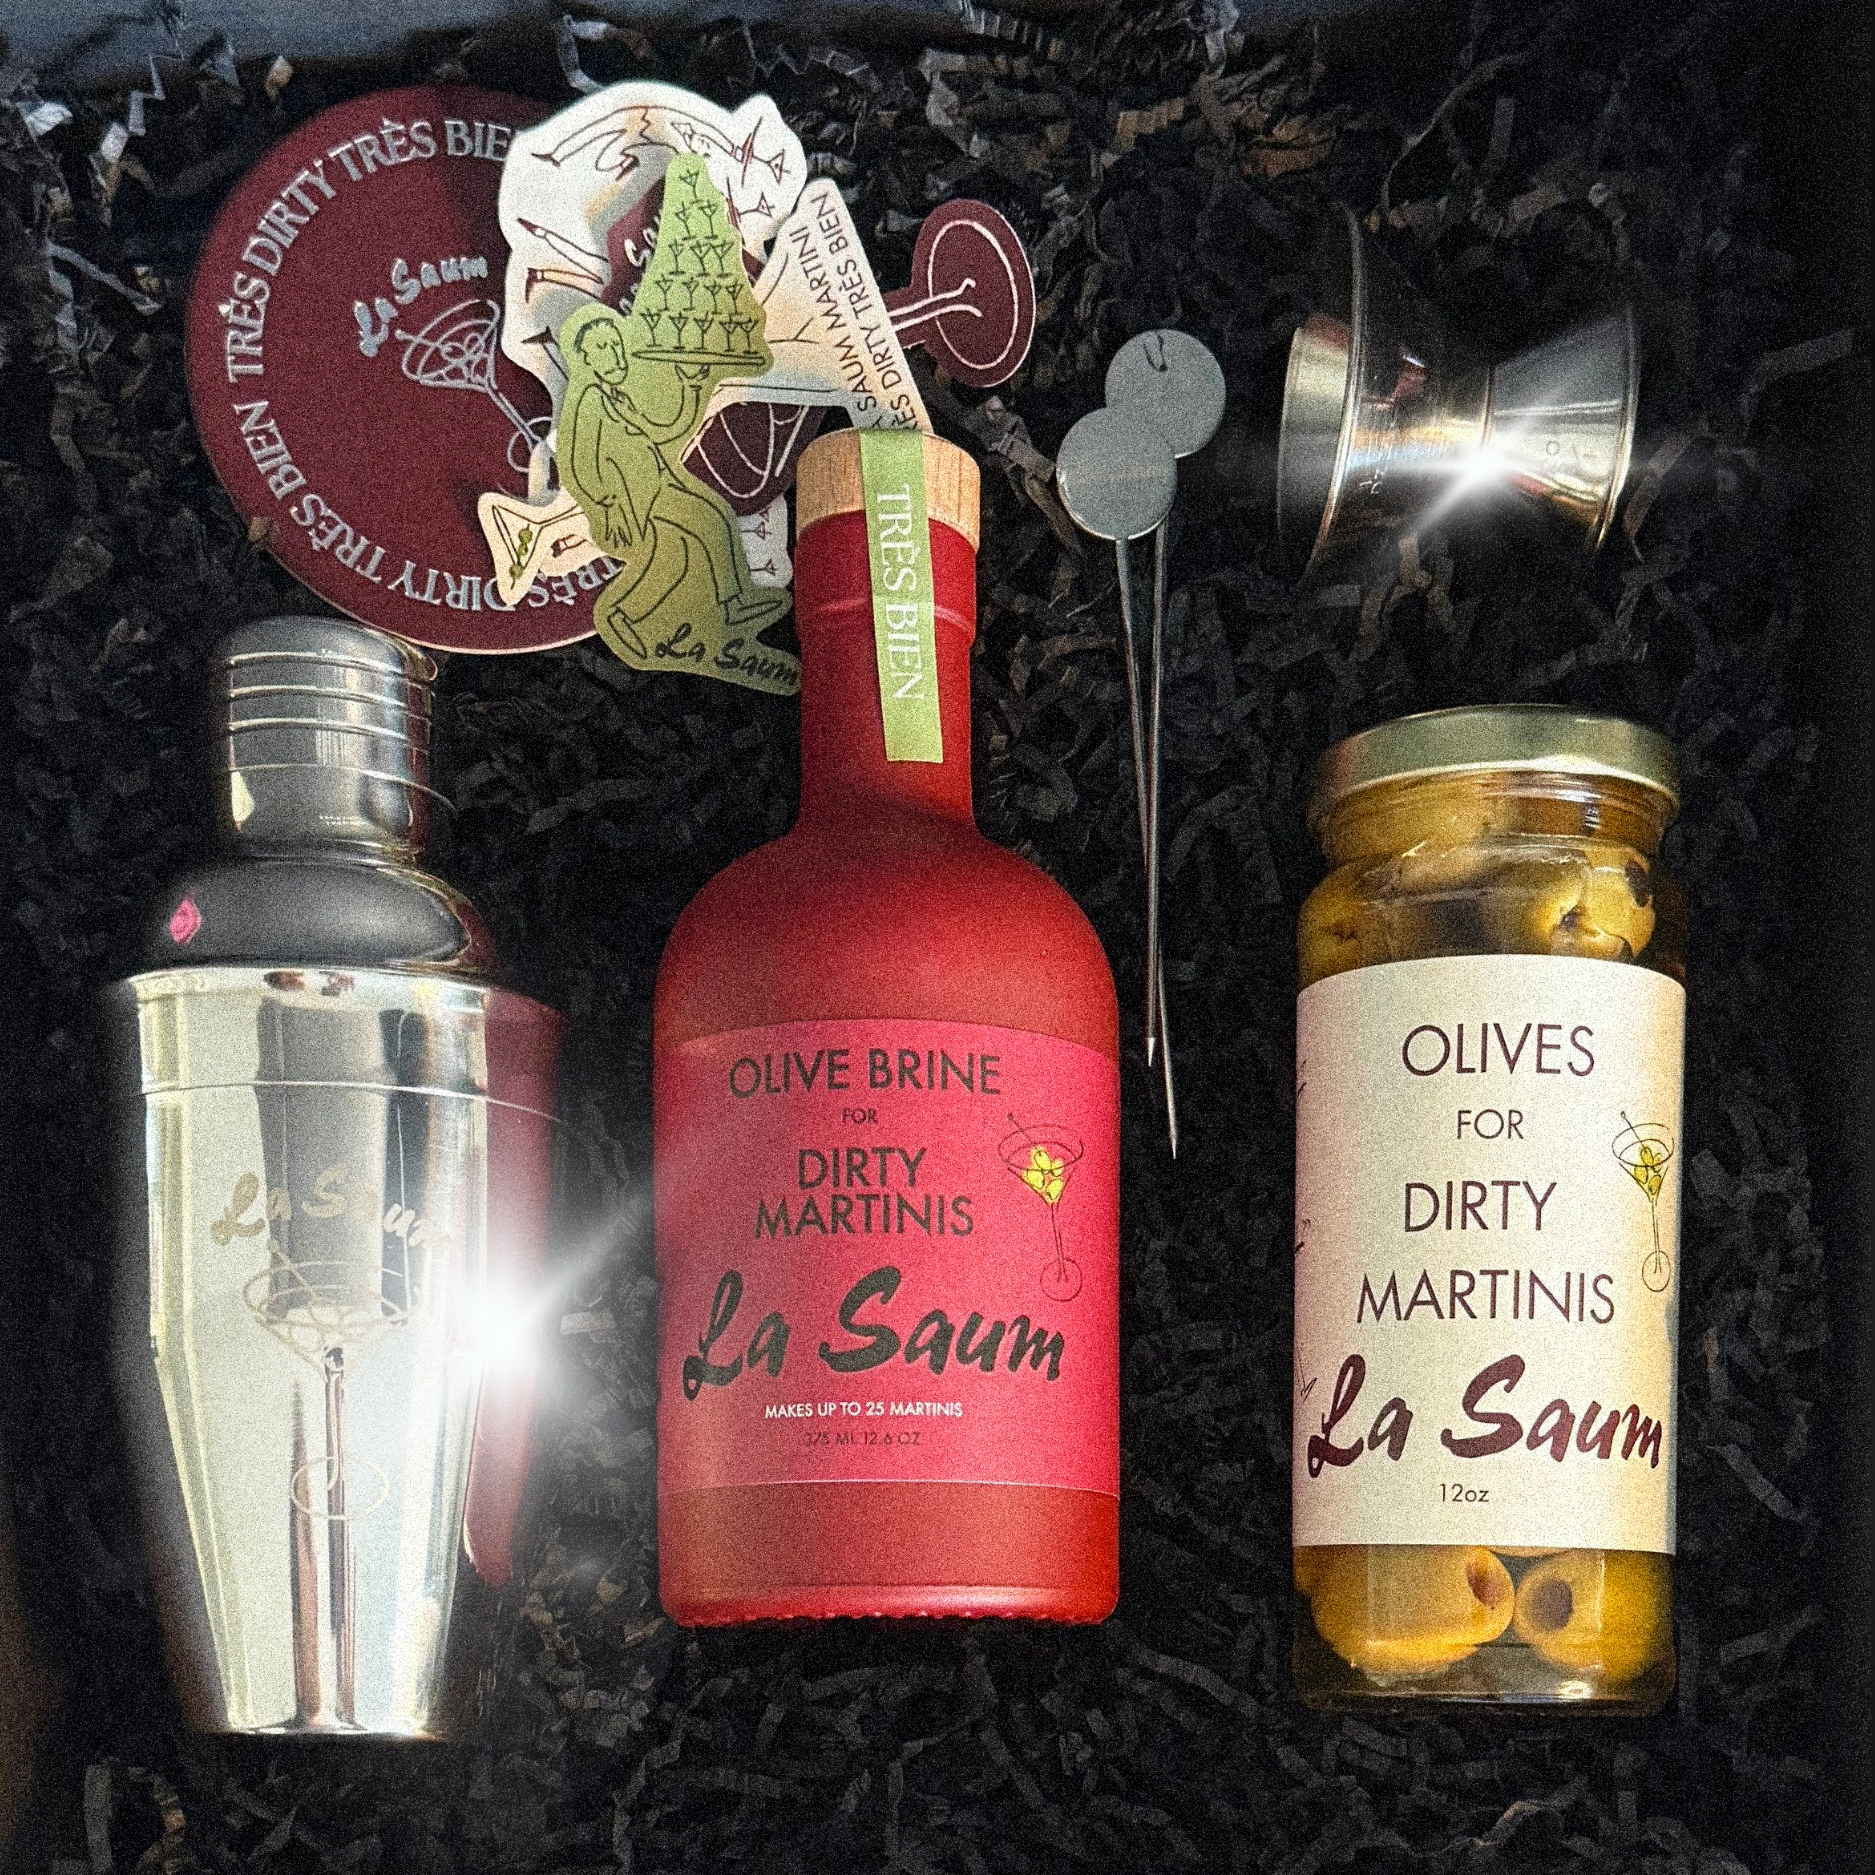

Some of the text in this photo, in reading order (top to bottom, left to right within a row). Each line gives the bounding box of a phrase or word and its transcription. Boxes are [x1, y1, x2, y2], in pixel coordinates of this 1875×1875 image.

[219, 117, 512, 383] TRÈS DIRTY TRÈS BIE
[812, 191, 849, 256] BIEN
[391, 256, 488, 305] Saum
[837, 258, 874, 321] TRÈS
[789, 226, 877, 412] SAUM MARTINI
[860, 323, 902, 390] DIRTY
[233, 400, 307, 500] BIEN
[290, 493, 387, 583] TRÈS
[876, 484, 925, 700] TRÈS BIEN
[655, 622, 798, 685] La Saum
[729, 1048, 1000, 1099] OLIVE BRINE
[1401, 1023, 1596, 1077] OLIVES
[842, 1107, 877, 1125] FOR
[1456, 1108, 1525, 1140] FOR
[798, 1147, 927, 1190] DIRTY
[754, 1192, 974, 1239] MARTINIS
[1404, 1180, 1558, 1233] DIRTY
[1356, 1268, 1616, 1325] MARTINIS
[682, 1265, 1065, 1401] La Saum
[765, 1401, 964, 1419] MAKES UP TO 25 MARTINIS
[897, 1430, 921, 1446] OZ
[1306, 1353, 1663, 1479] La Saum
[1438, 1483, 1490, 1503] 12oz
